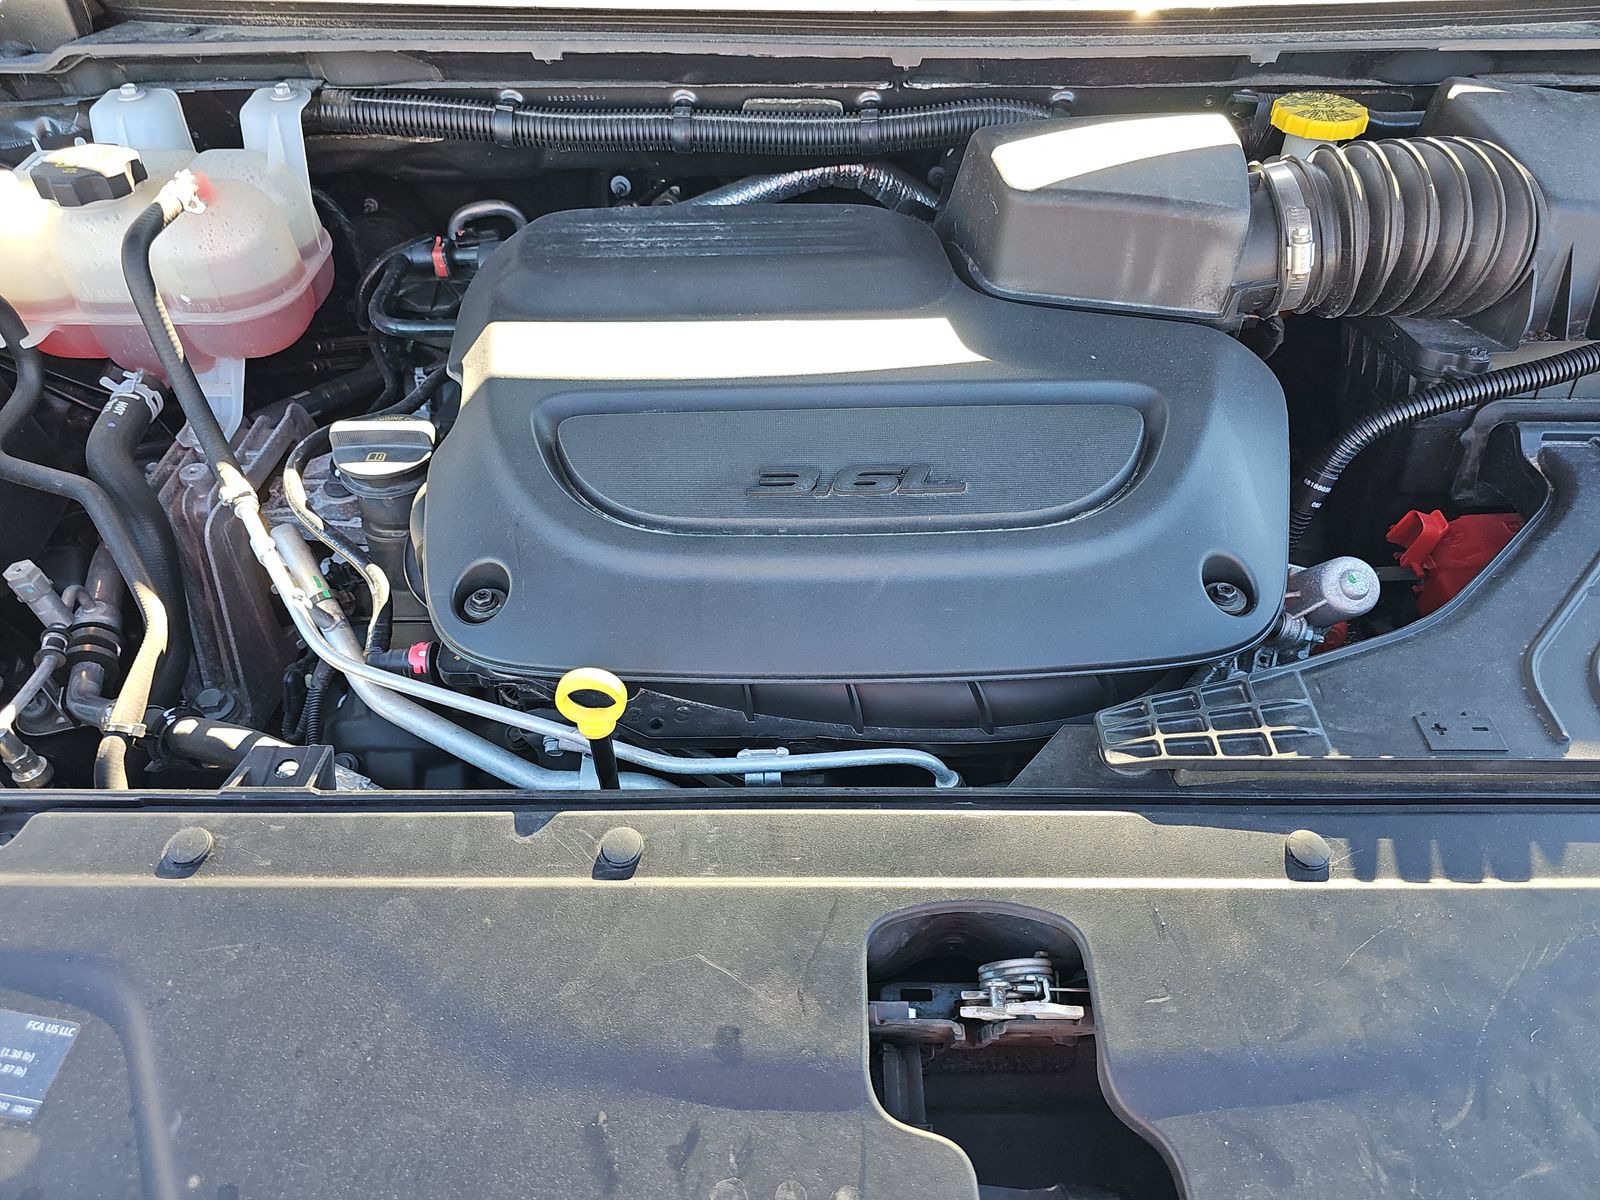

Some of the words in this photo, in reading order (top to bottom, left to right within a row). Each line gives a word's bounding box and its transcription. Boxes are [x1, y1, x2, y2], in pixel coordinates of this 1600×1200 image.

[745, 463, 967, 498] 3.6L
[26, 1020, 44, 1032] FCA
[44, 1023, 60, 1034] US
[59, 1025, 77, 1037] LLC
[22, 1050, 36, 1063] lb)
[14, 1066, 28, 1078] lb)
